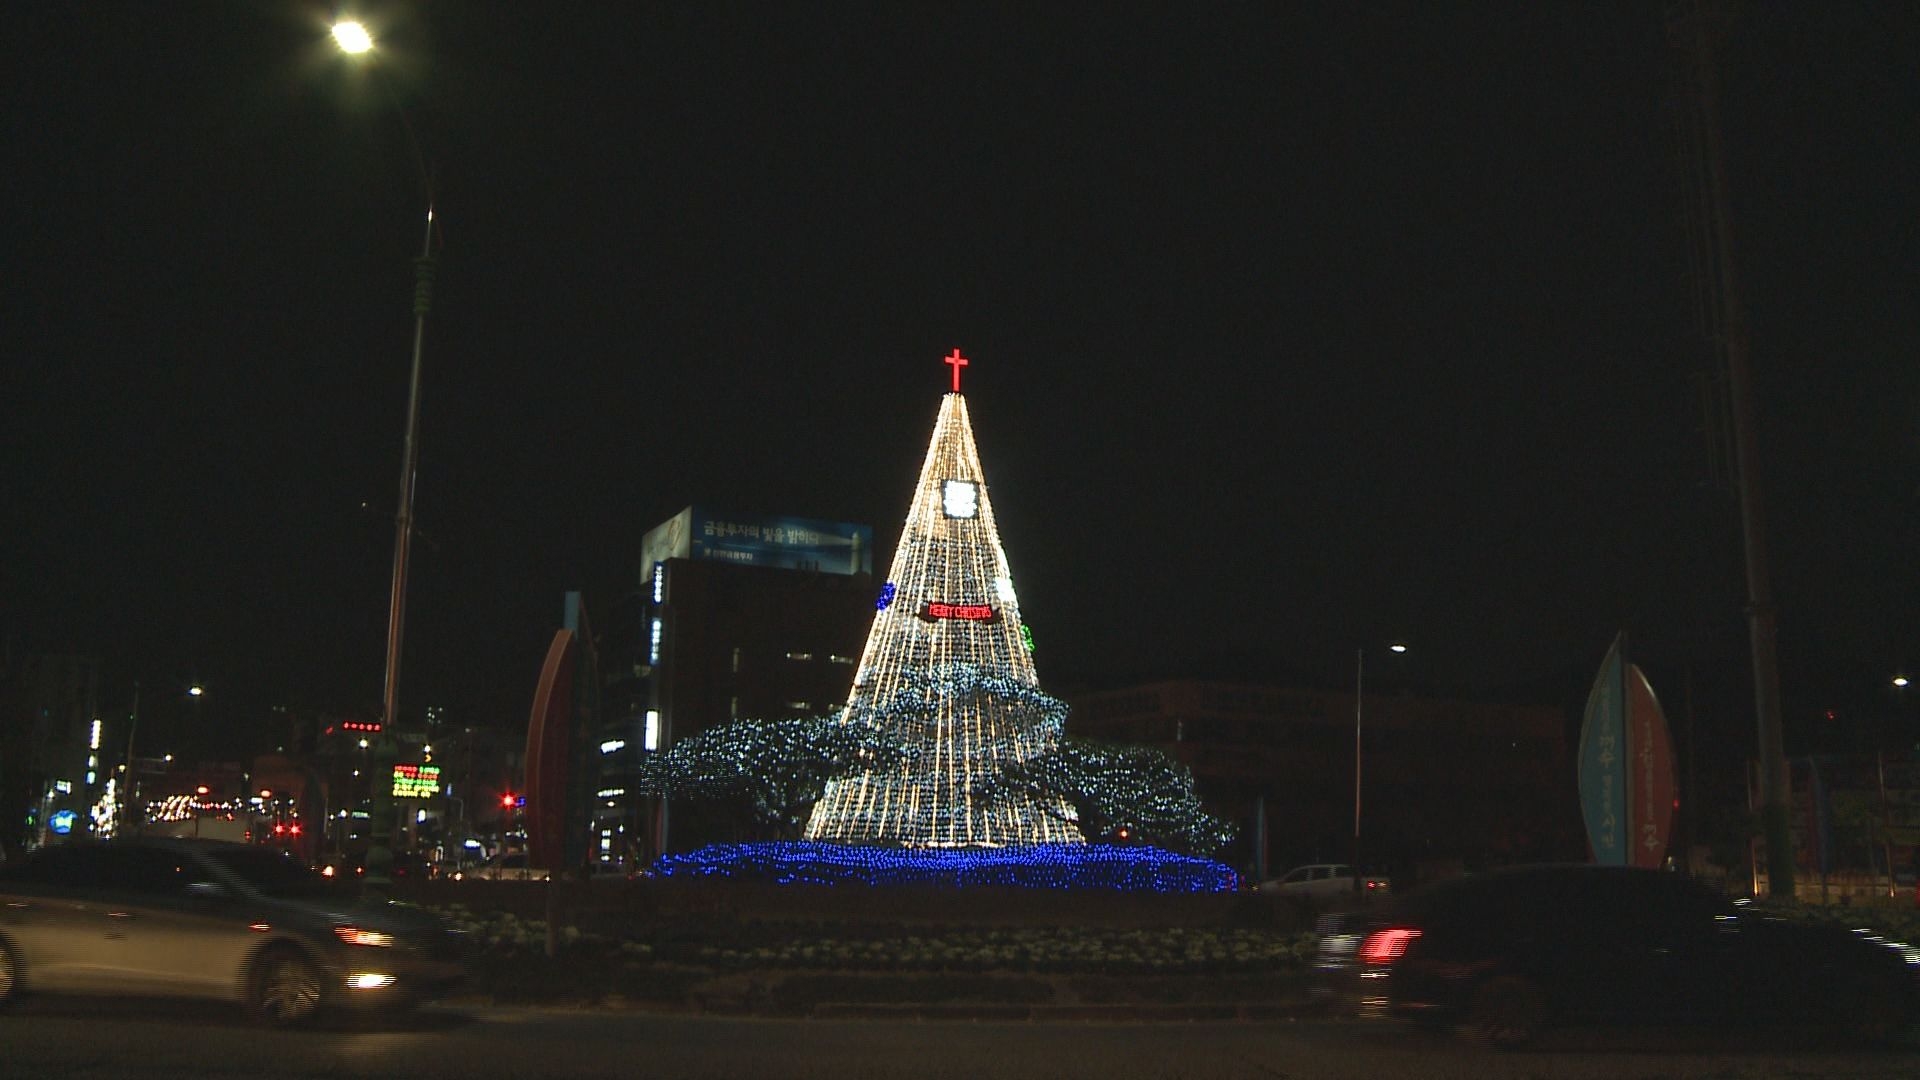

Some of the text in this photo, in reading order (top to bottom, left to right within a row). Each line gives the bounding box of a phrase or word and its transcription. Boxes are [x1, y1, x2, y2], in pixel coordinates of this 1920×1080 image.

[703, 520, 819, 545] 금융투자의 빛을 밝히다
